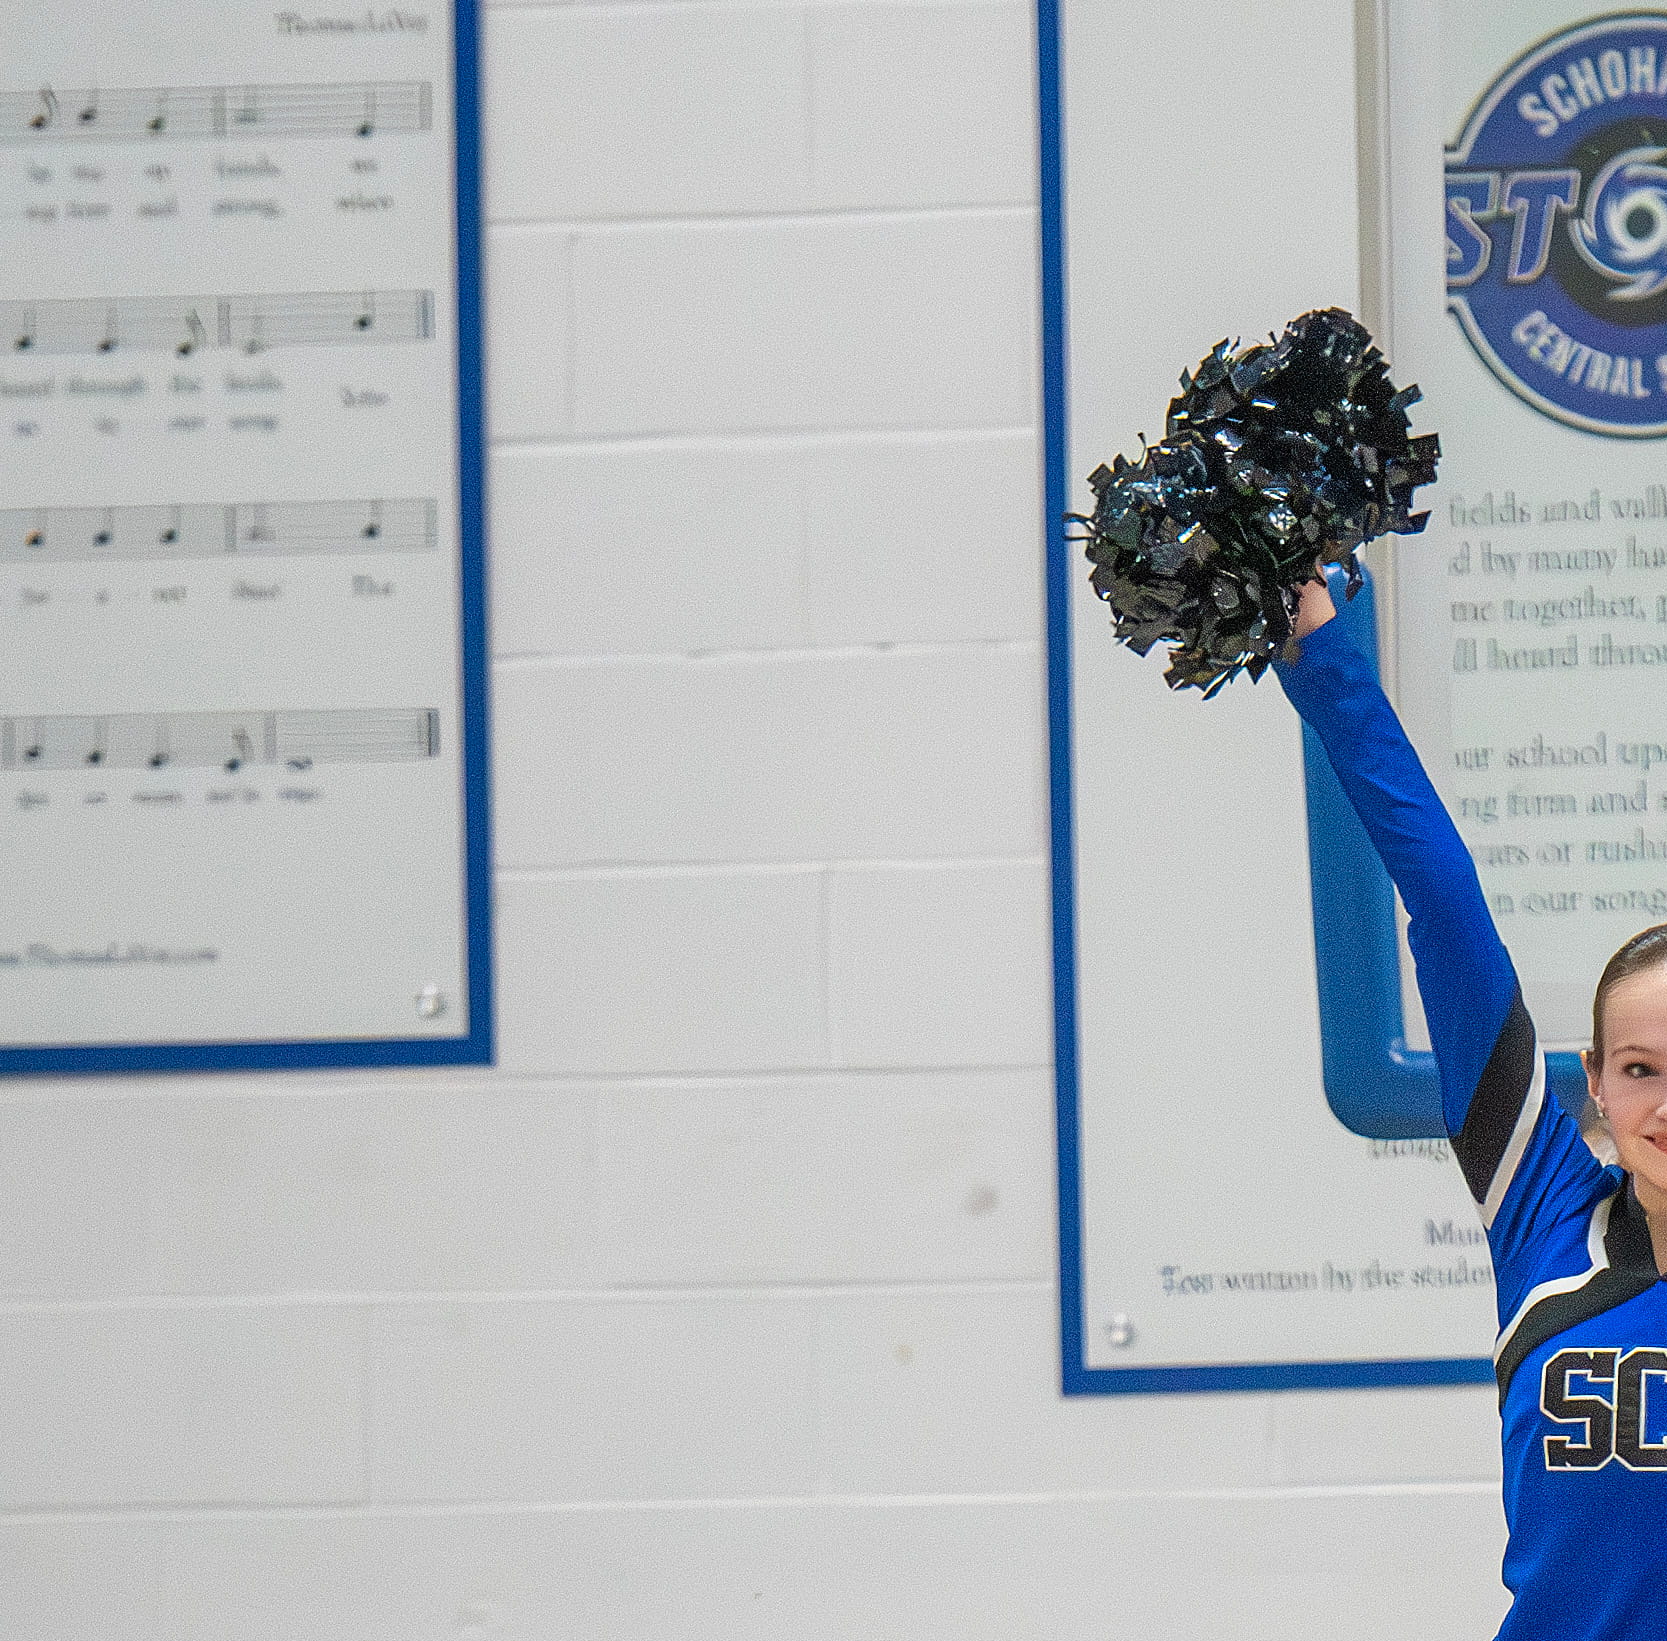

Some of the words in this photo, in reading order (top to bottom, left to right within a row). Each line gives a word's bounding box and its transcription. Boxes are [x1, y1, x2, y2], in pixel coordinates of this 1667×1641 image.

[1512, 308, 1652, 398] CENTRAL
[1541, 489, 1601, 523] and
[1481, 539, 1518, 577] by
[1528, 547, 1616, 577] many
[1504, 585, 1647, 628] together,
[1487, 633, 1578, 671] heard
[1505, 731, 1608, 769] school
[1587, 781, 1648, 815] and
